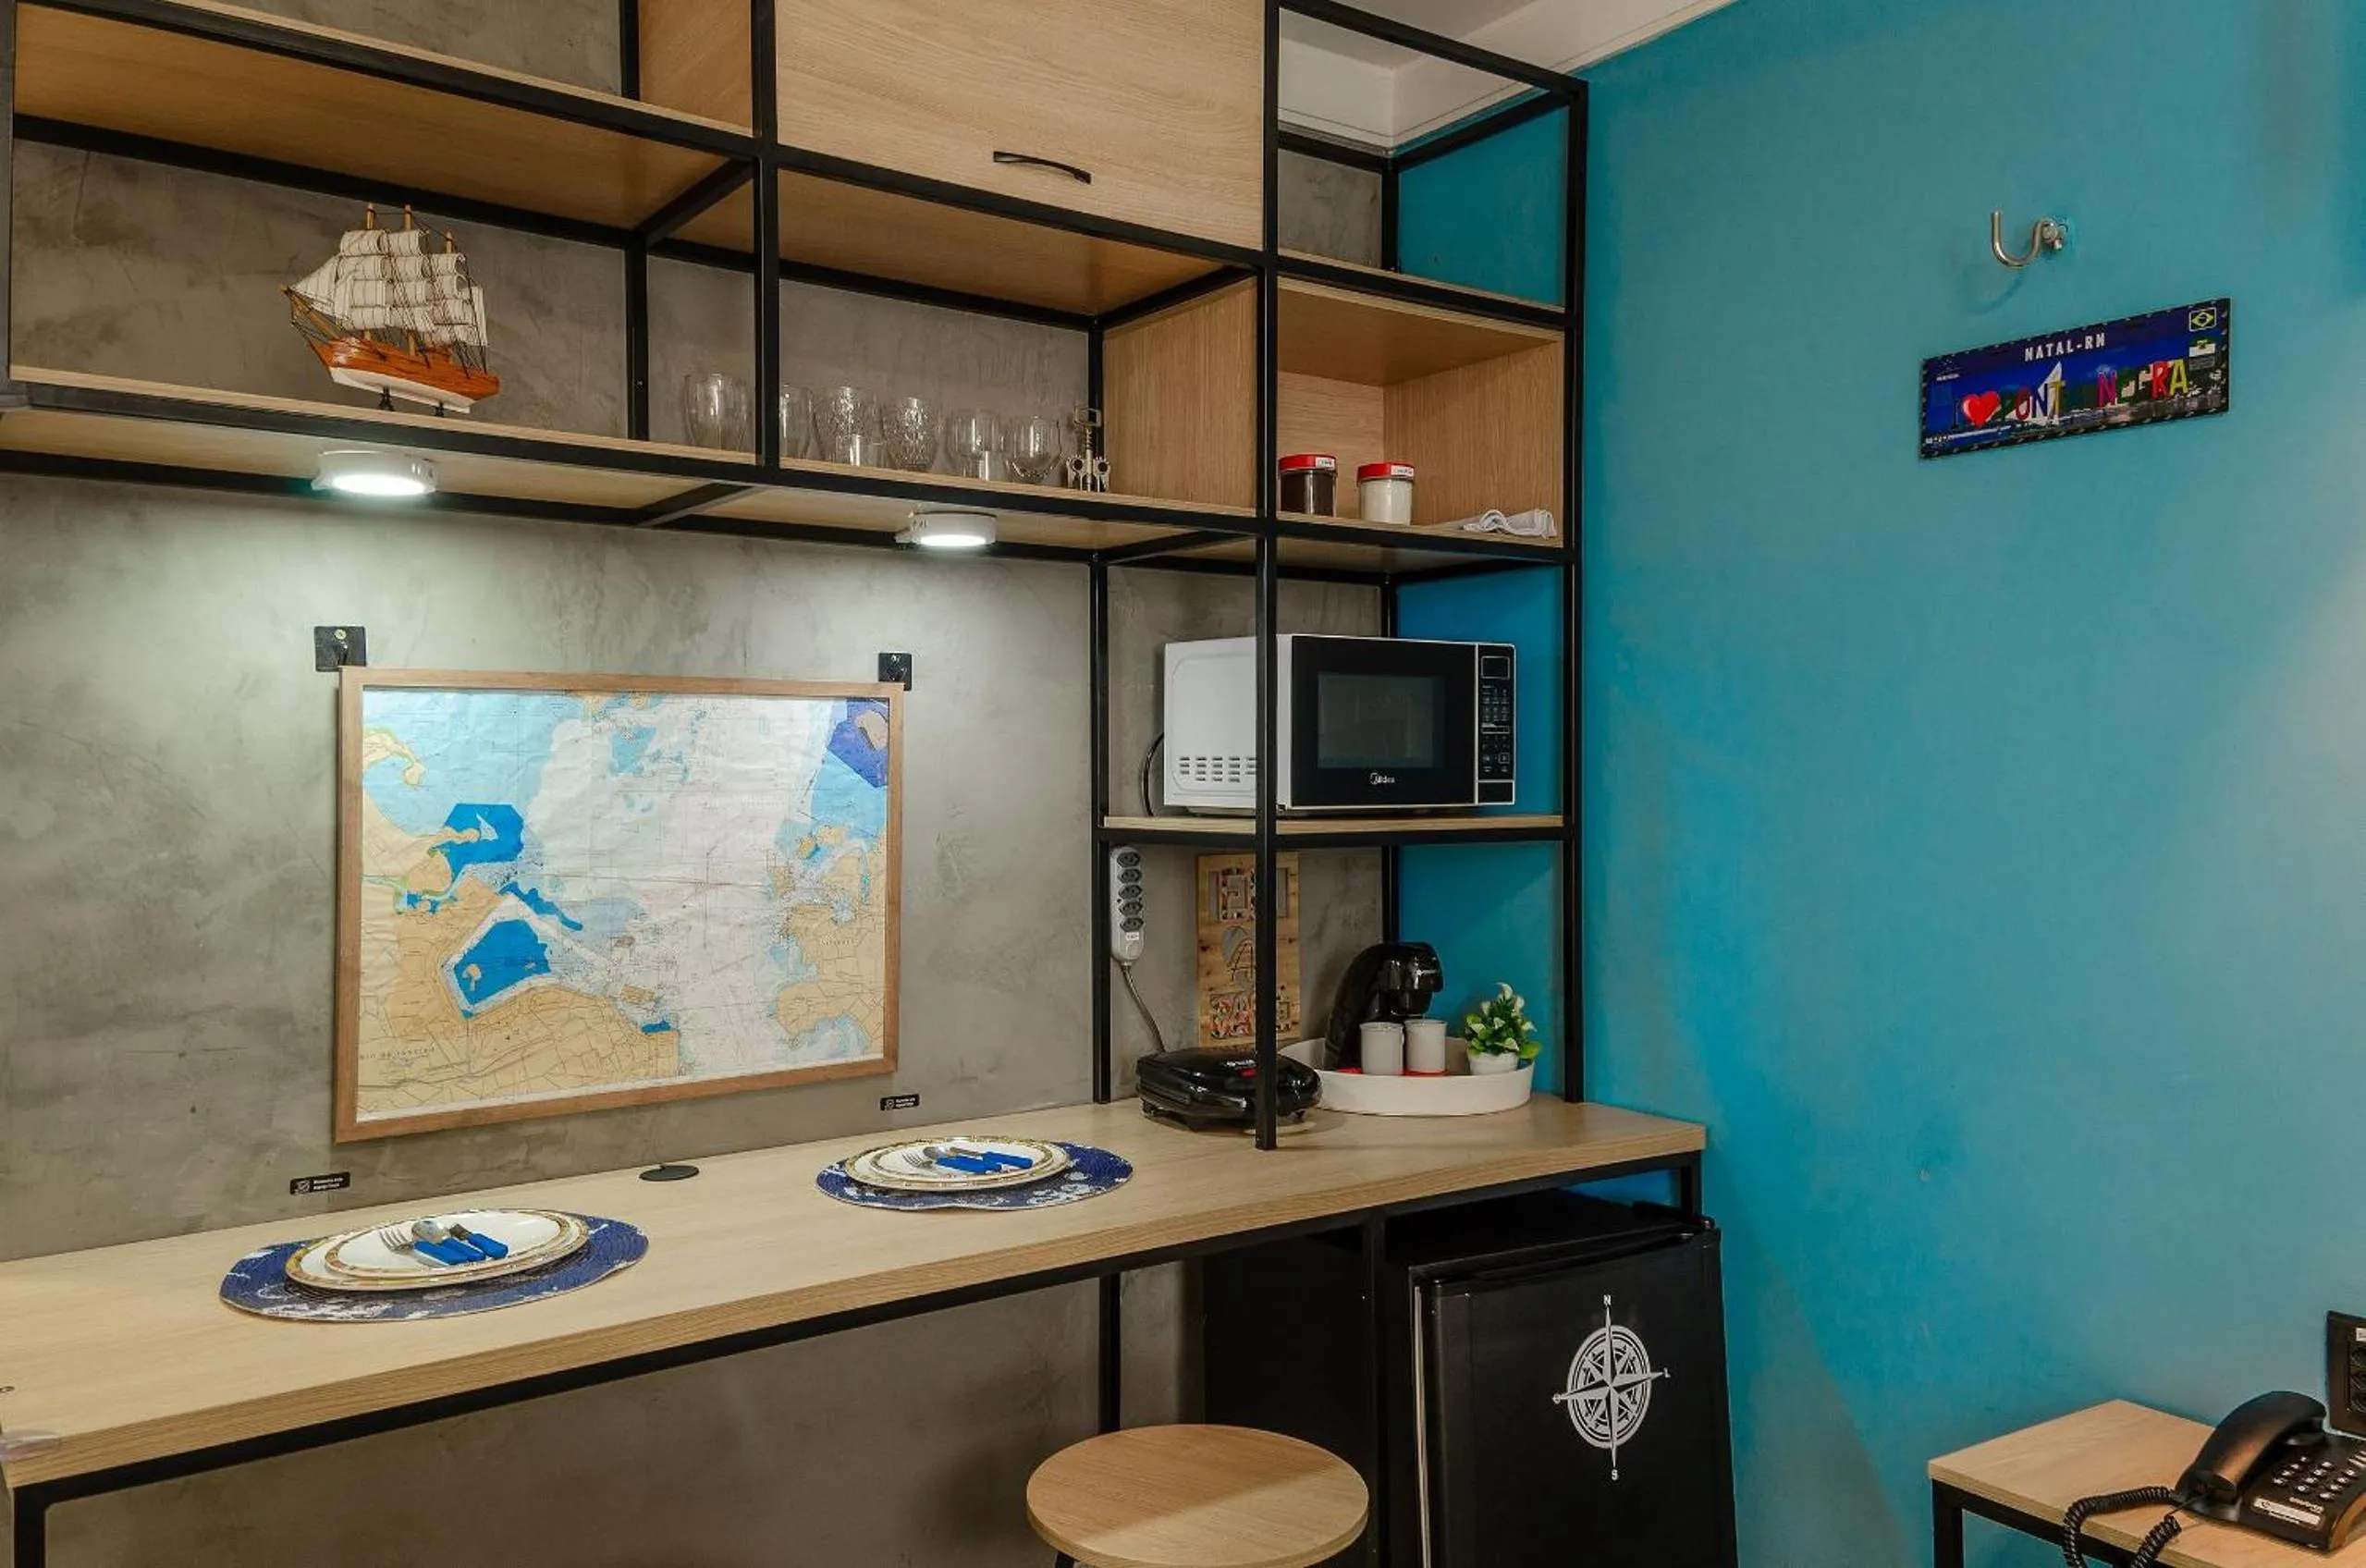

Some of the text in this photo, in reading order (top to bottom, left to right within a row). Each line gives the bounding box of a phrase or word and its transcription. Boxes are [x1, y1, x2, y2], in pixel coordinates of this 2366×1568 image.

[2024, 332, 2105, 362] NATAL-RN
[1602, 1294, 1612, 1306] N
[1611, 1469, 1619, 1481] S
